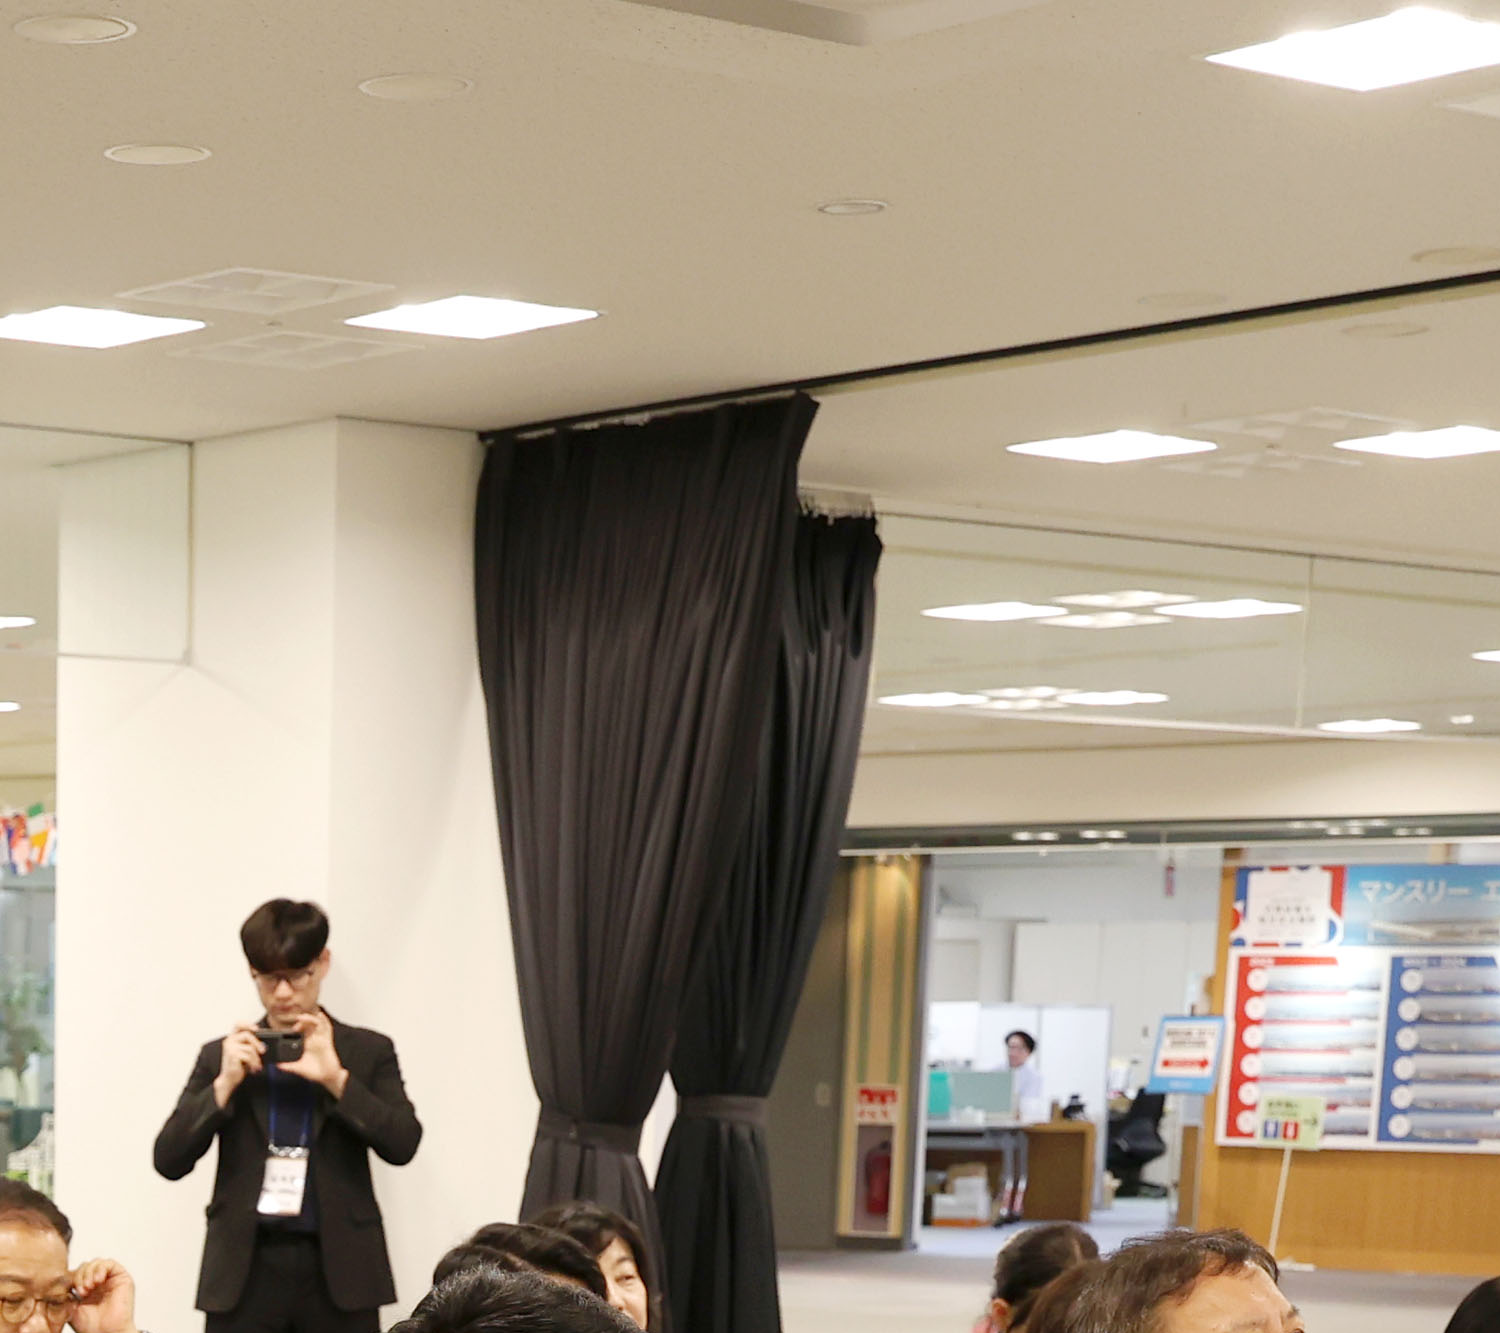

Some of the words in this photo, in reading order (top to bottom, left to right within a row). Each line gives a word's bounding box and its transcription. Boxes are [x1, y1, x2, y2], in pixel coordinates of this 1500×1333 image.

[1358, 878, 1472, 904] マンスリー
